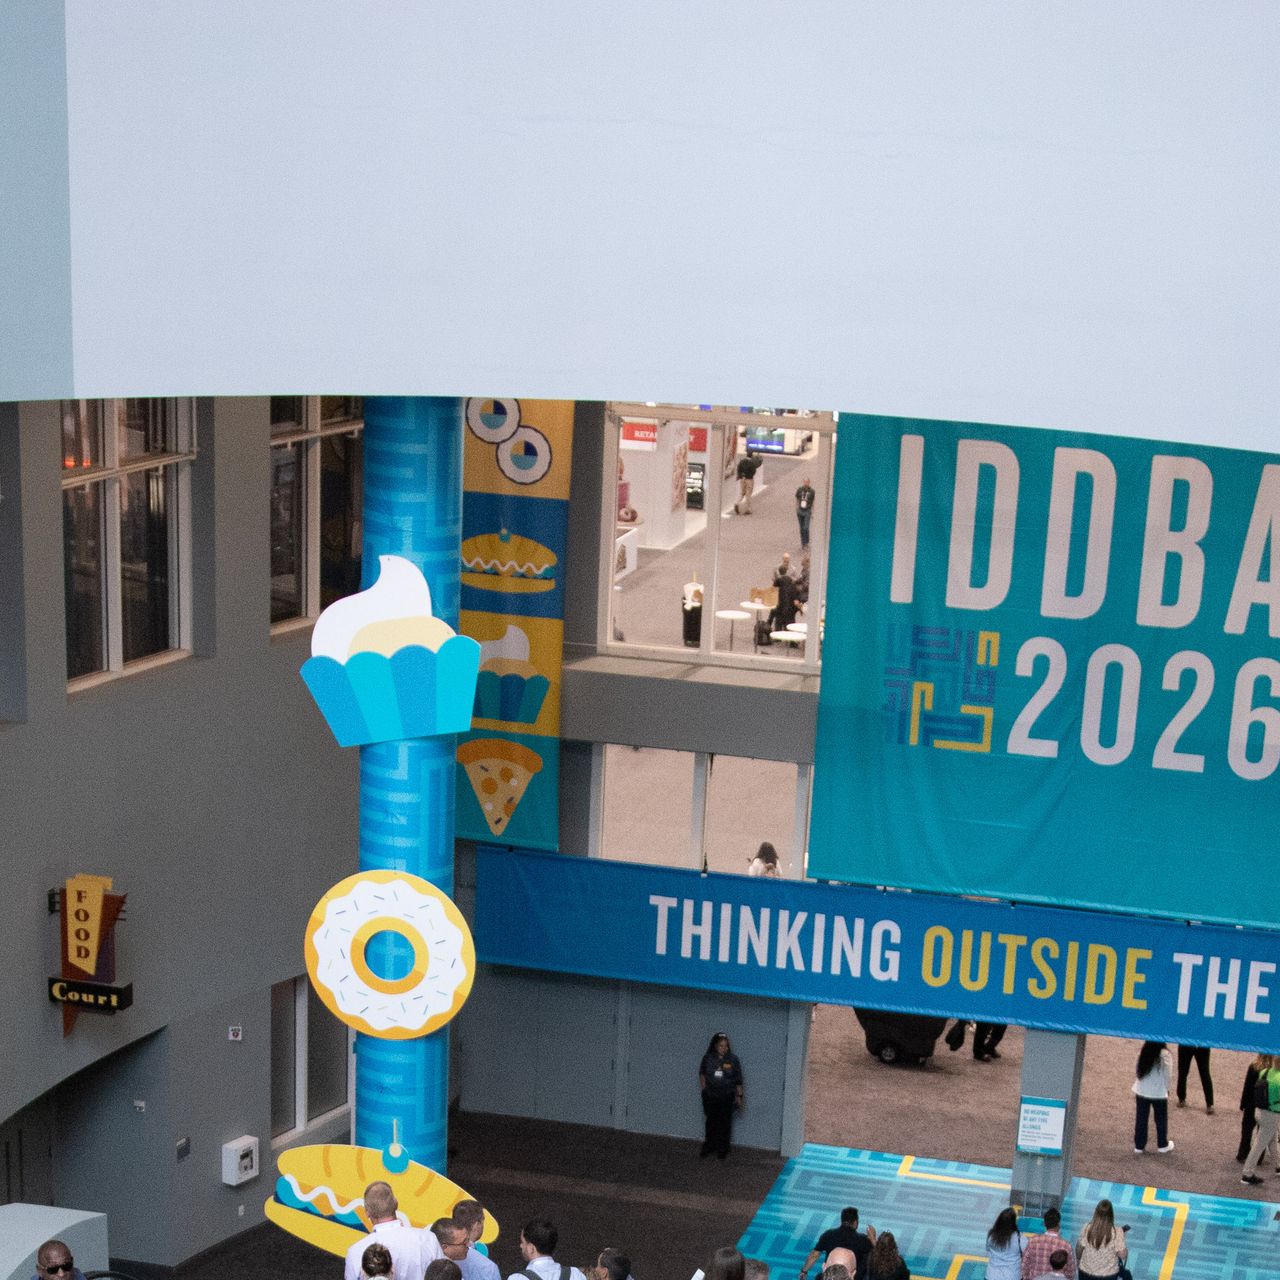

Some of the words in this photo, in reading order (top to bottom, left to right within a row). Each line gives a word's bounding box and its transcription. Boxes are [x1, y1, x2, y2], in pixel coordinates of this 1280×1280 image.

[74, 889, 90, 959] FOOD
[51, 981, 118, 1007] Court
[649, 895, 902, 983] THINKING
[921, 925, 1152, 1011] OUTSIDE
[1173, 952, 1278, 1025] THE
